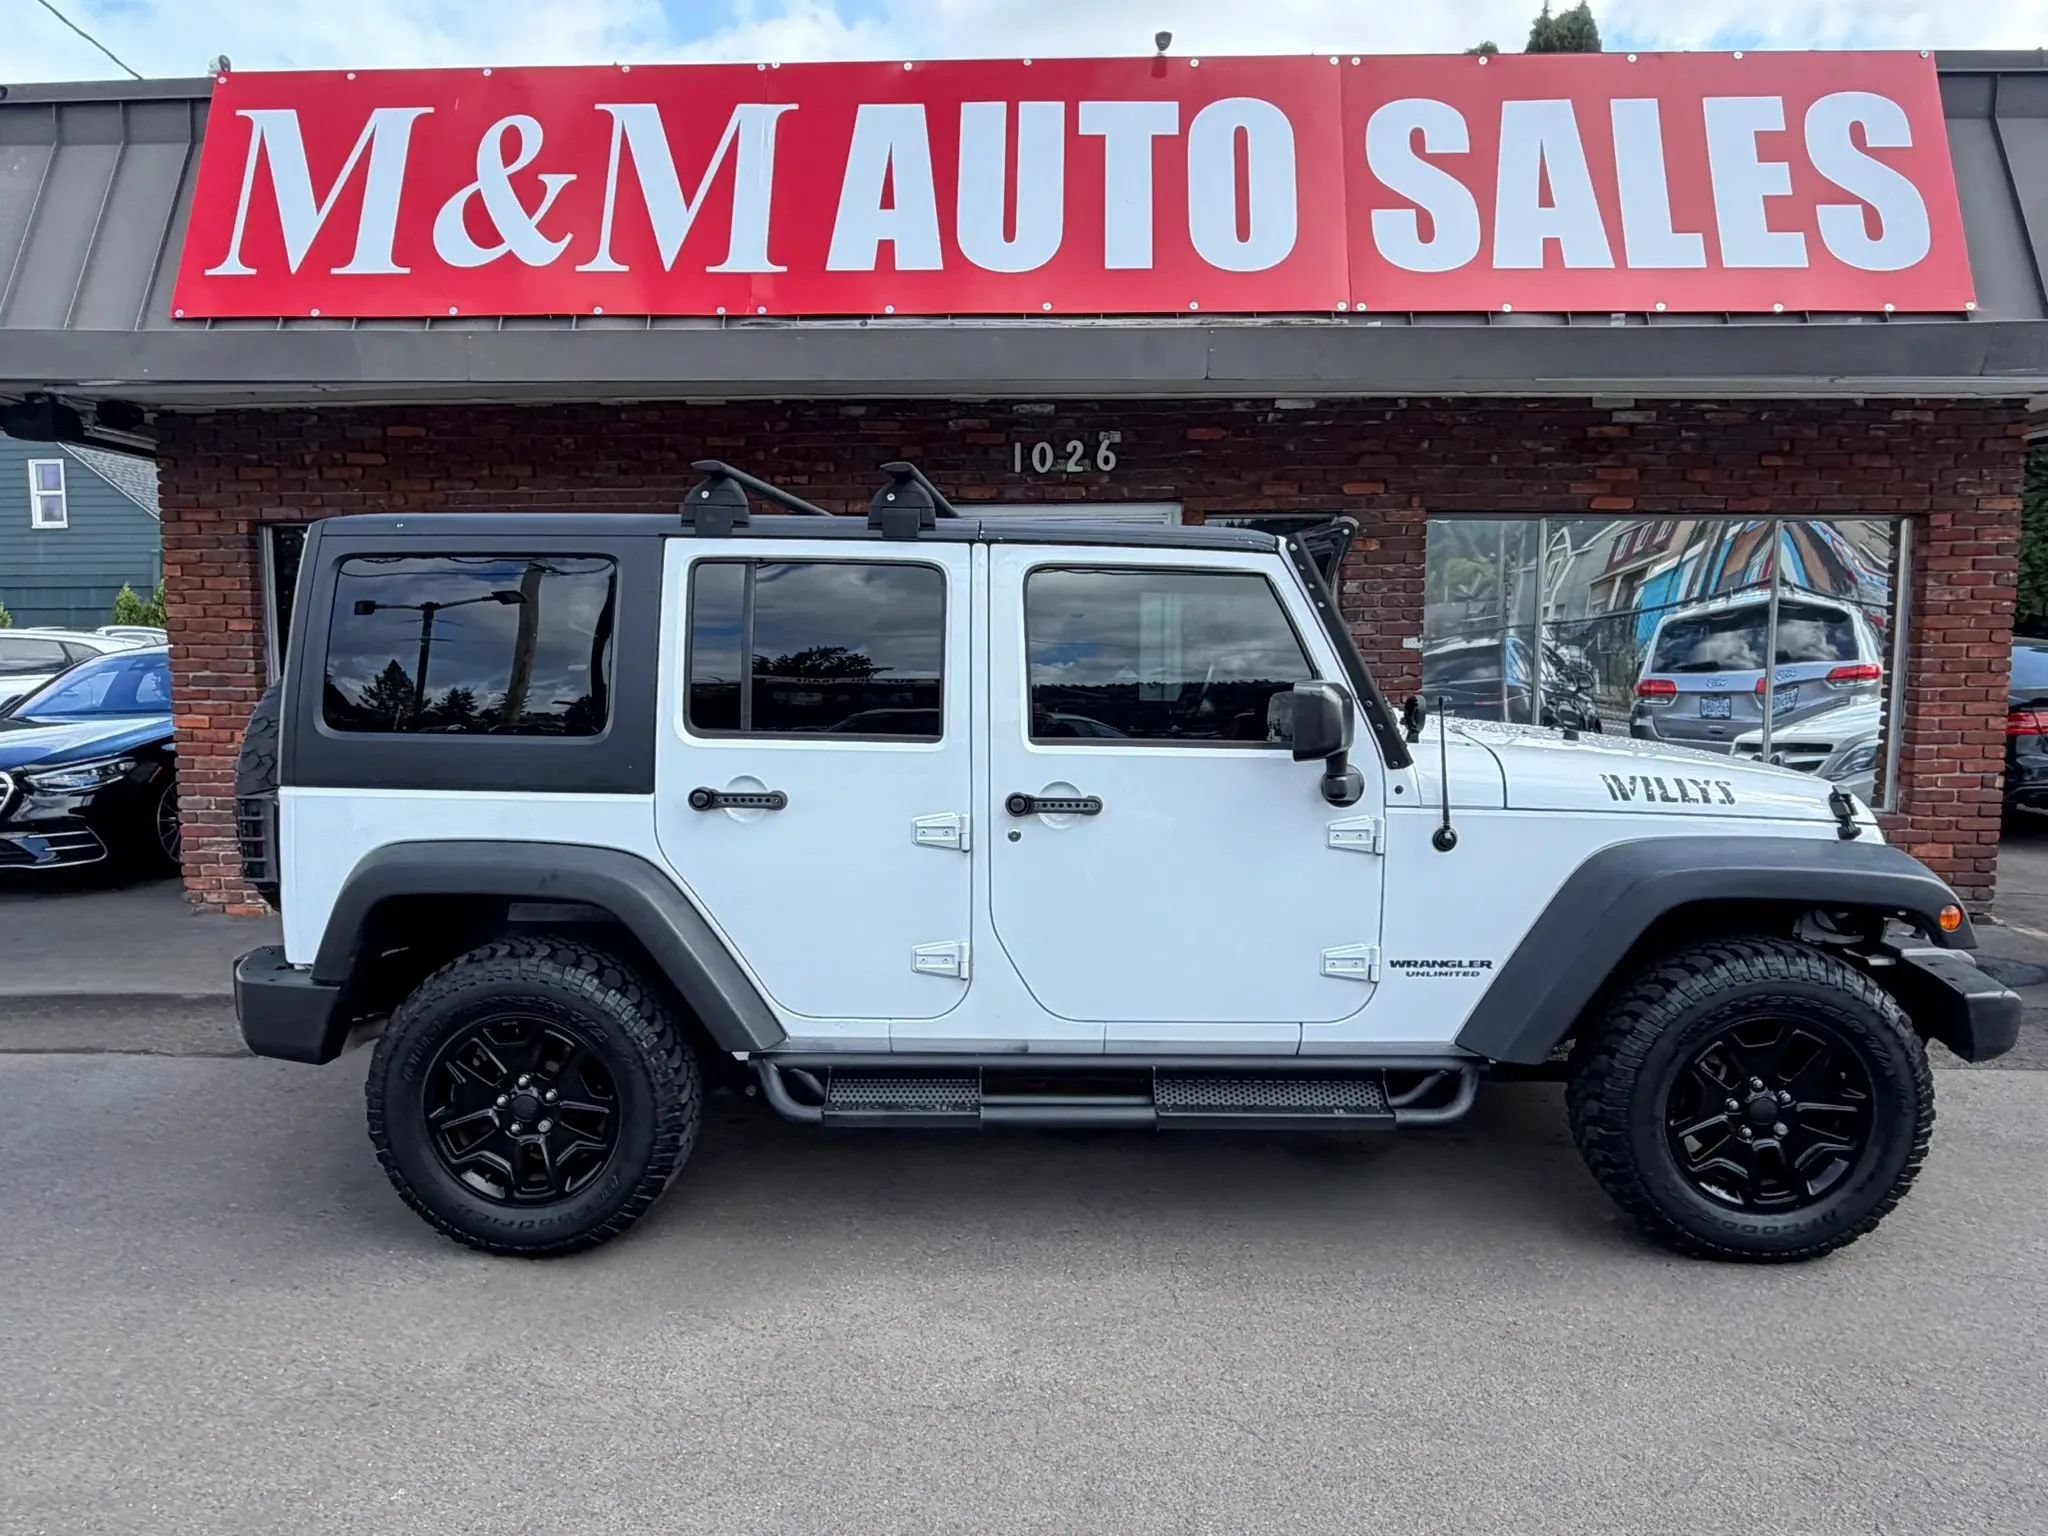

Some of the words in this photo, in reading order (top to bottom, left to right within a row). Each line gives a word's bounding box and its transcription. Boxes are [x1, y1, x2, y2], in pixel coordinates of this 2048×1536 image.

[204, 104, 799, 275] M&M
[825, 96, 1298, 273] AUTO
[1365, 90, 1932, 272] SALES
[1014, 440, 1117, 473] 1026
[1599, 773, 1735, 805] WILLYS
[1389, 959, 1493, 969] WRANGLER
